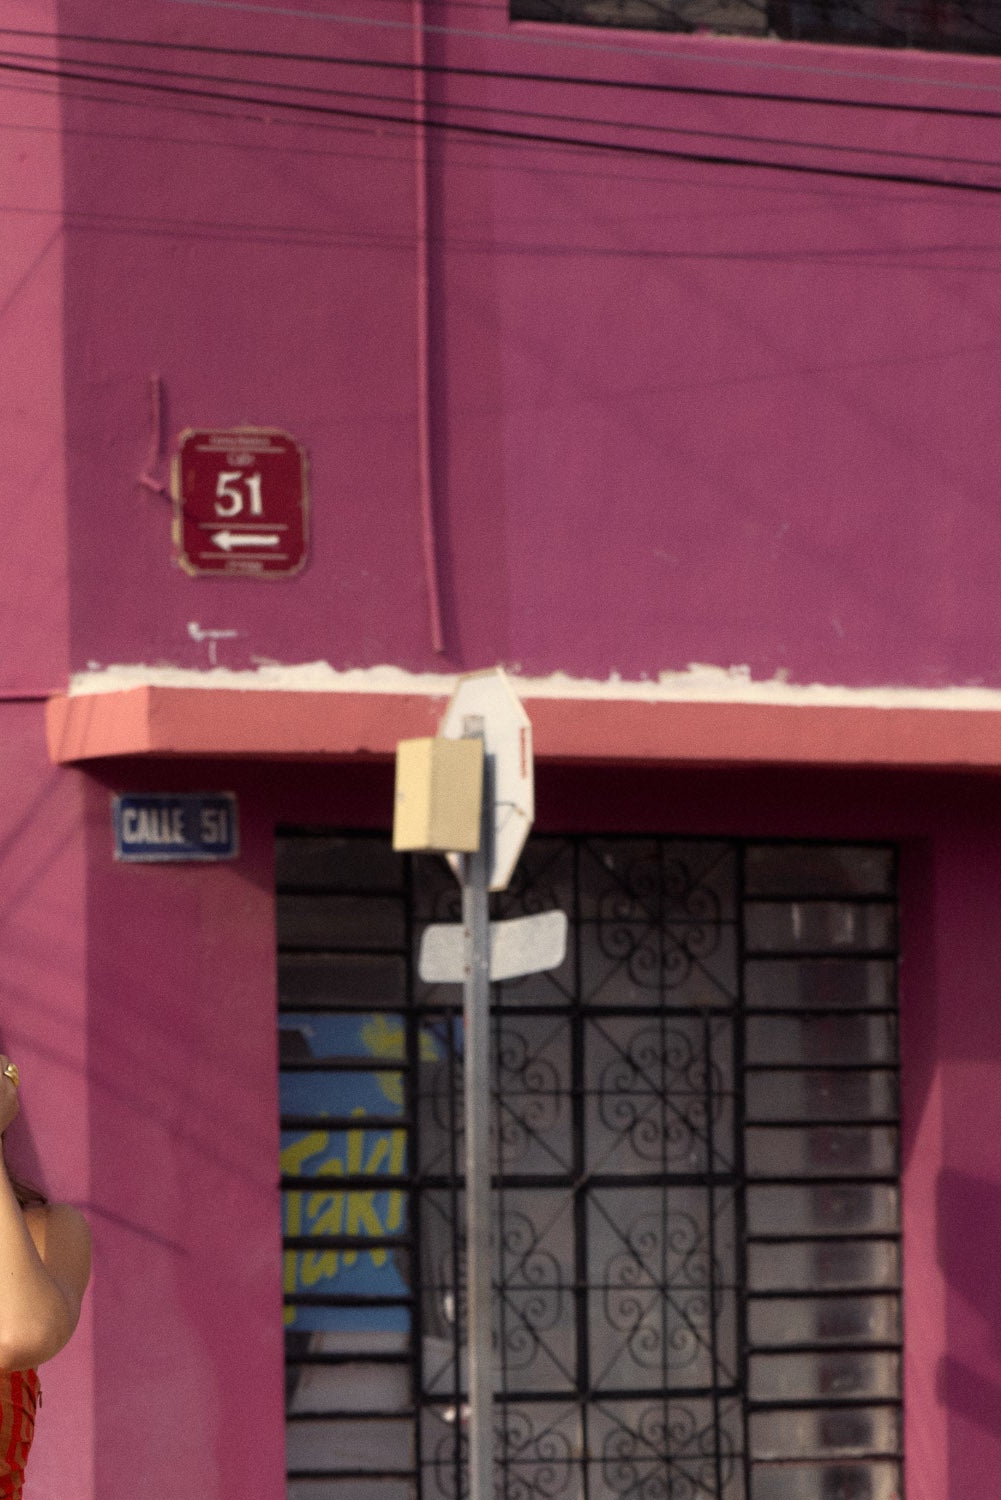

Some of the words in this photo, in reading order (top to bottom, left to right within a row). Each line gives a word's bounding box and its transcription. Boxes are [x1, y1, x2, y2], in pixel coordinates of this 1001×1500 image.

[214, 471, 263, 517] 51
[122, 807, 185, 844] CALLE
[201, 807, 229, 844] 51
